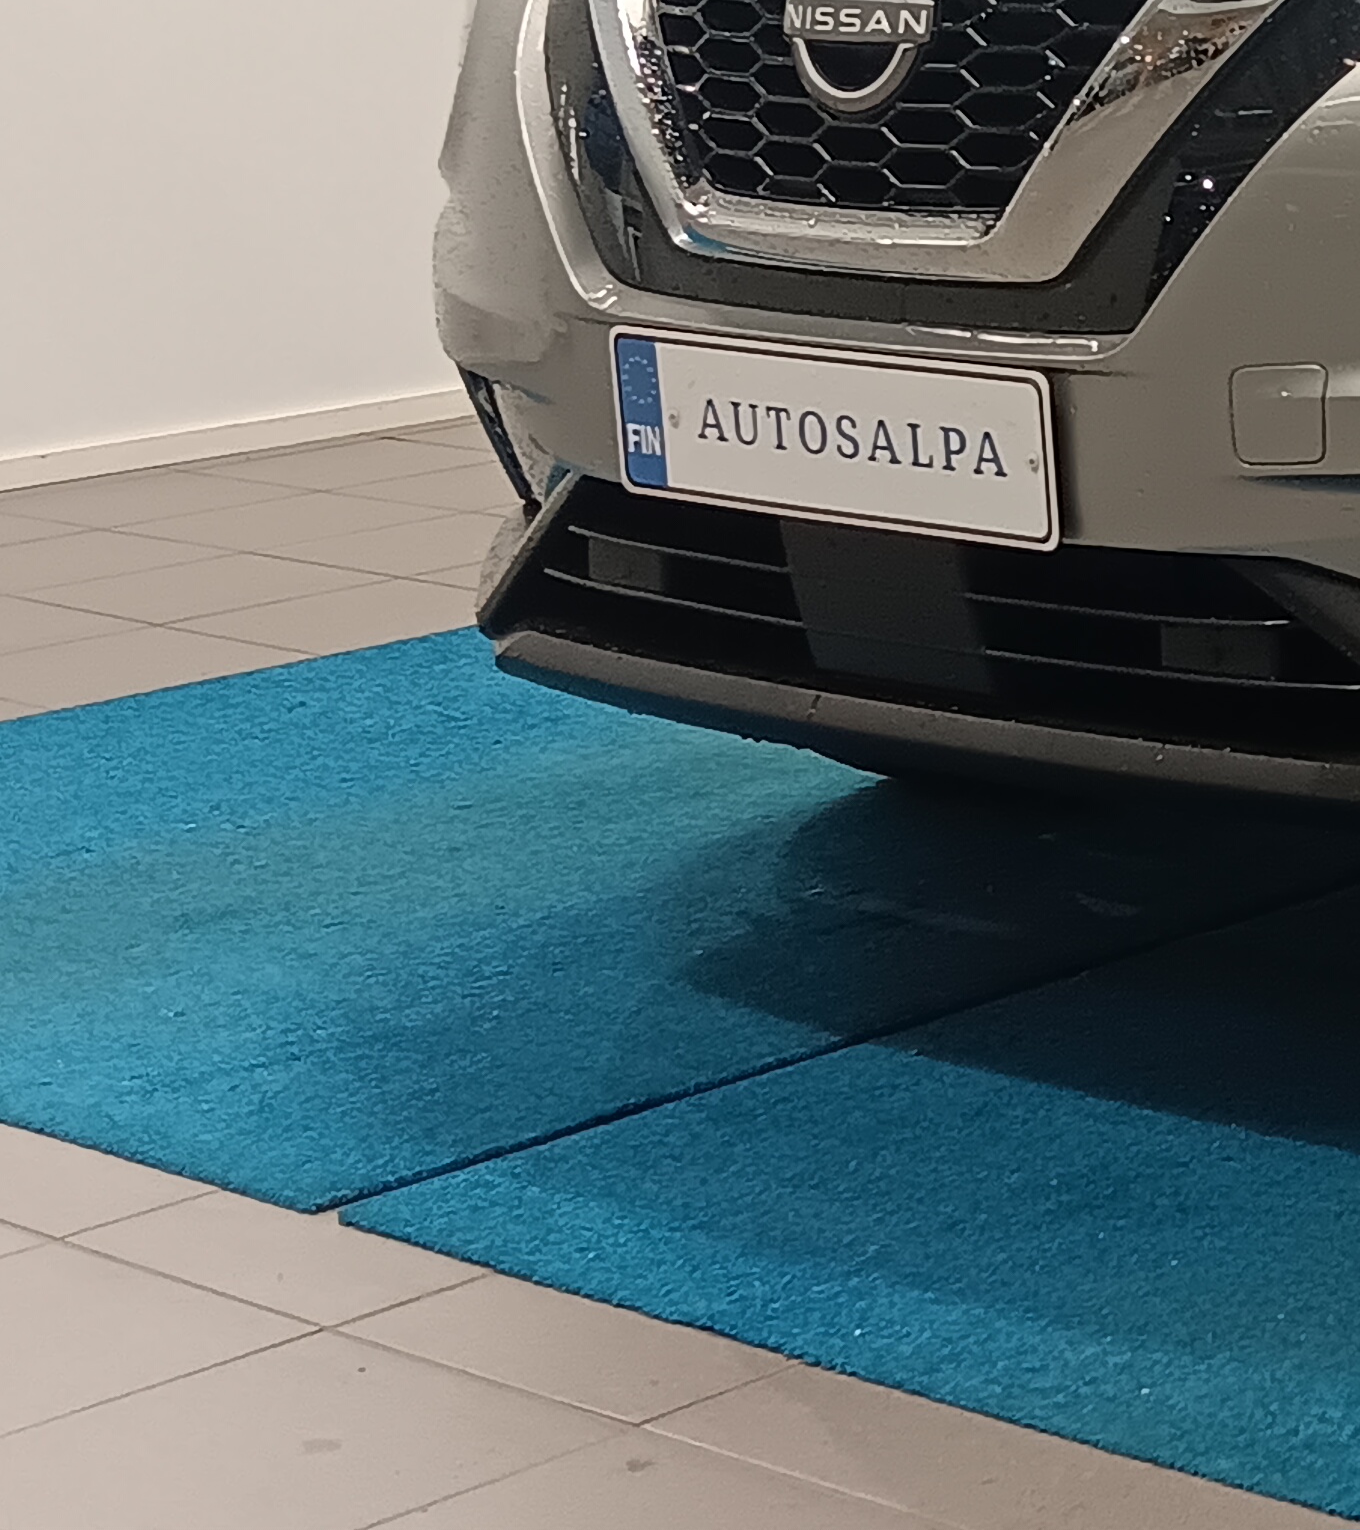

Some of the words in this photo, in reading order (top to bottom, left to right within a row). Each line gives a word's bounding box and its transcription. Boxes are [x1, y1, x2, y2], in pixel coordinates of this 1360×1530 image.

[788, 4, 927, 34] NISSAN
[627, 423, 662, 456] FIN
[697, 399, 1008, 477] AUTOSALPA
